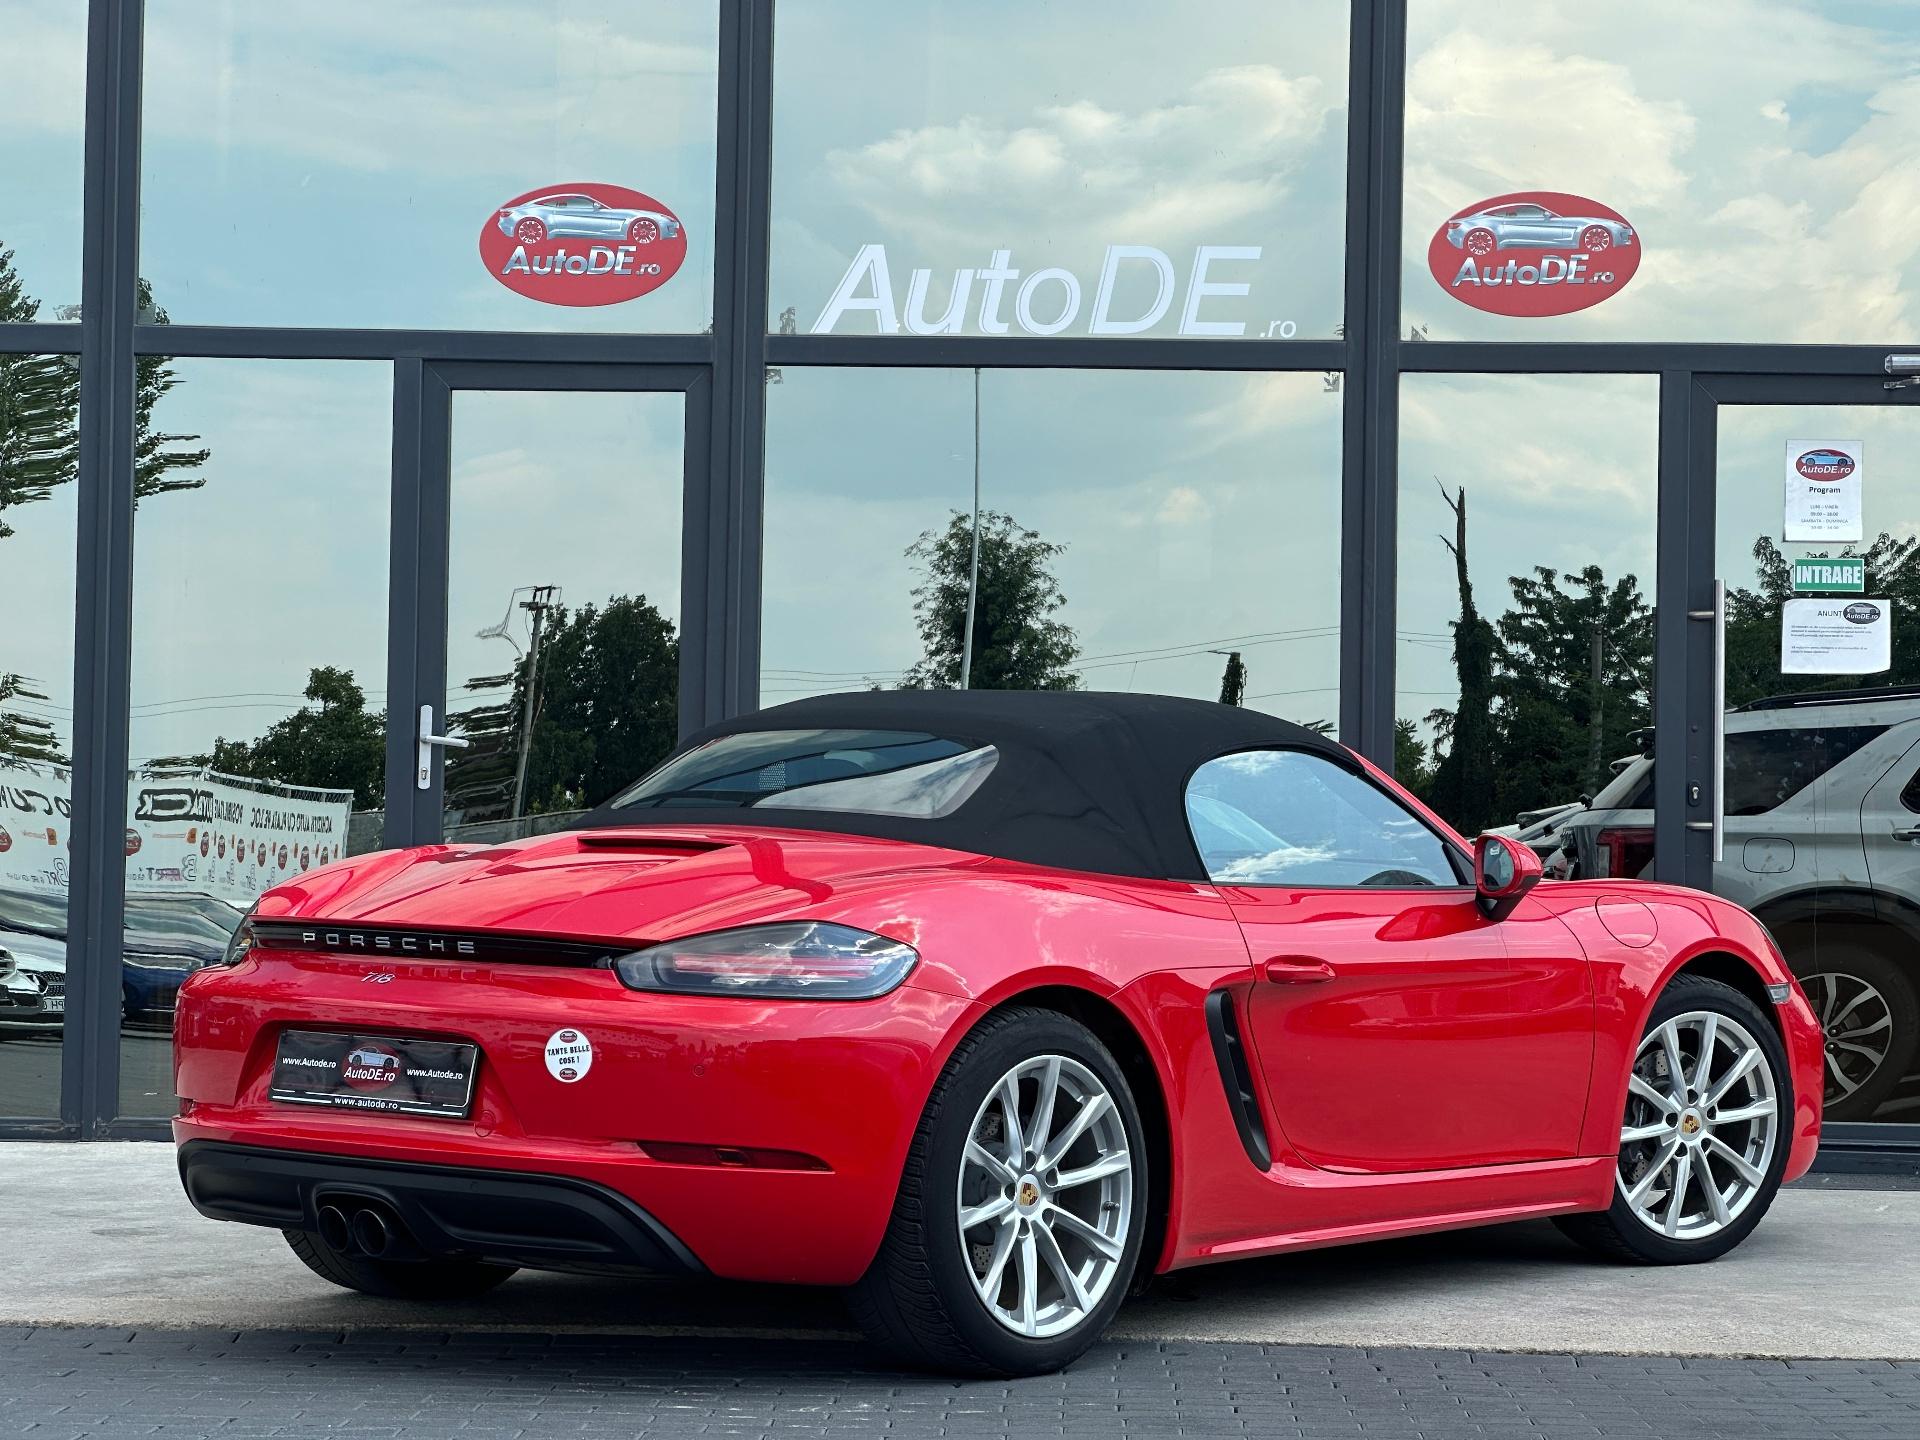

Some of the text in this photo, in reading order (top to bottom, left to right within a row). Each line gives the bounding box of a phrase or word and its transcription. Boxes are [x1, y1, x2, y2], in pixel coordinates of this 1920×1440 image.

[1800, 465, 1851, 474] AutoDE.ro
[1809, 486, 1841, 495] Program
[1796, 565, 1861, 584] INTRARE
[1845, 612, 1879, 621] AutoDE.ro
[302, 932, 475, 954] PORSCHE
[360, 971, 396, 985] 718
[547, 1045, 590, 1056] TANTE BELLE
[282, 1056, 337, 1069] www.Autode.ro
[558, 1056, 575, 1065] COSE
[343, 1066, 396, 1082] AutoDE.ro
[406, 1067, 464, 1080] www.Autode.ro
[334, 1096, 398, 1110] www.autode.ro
